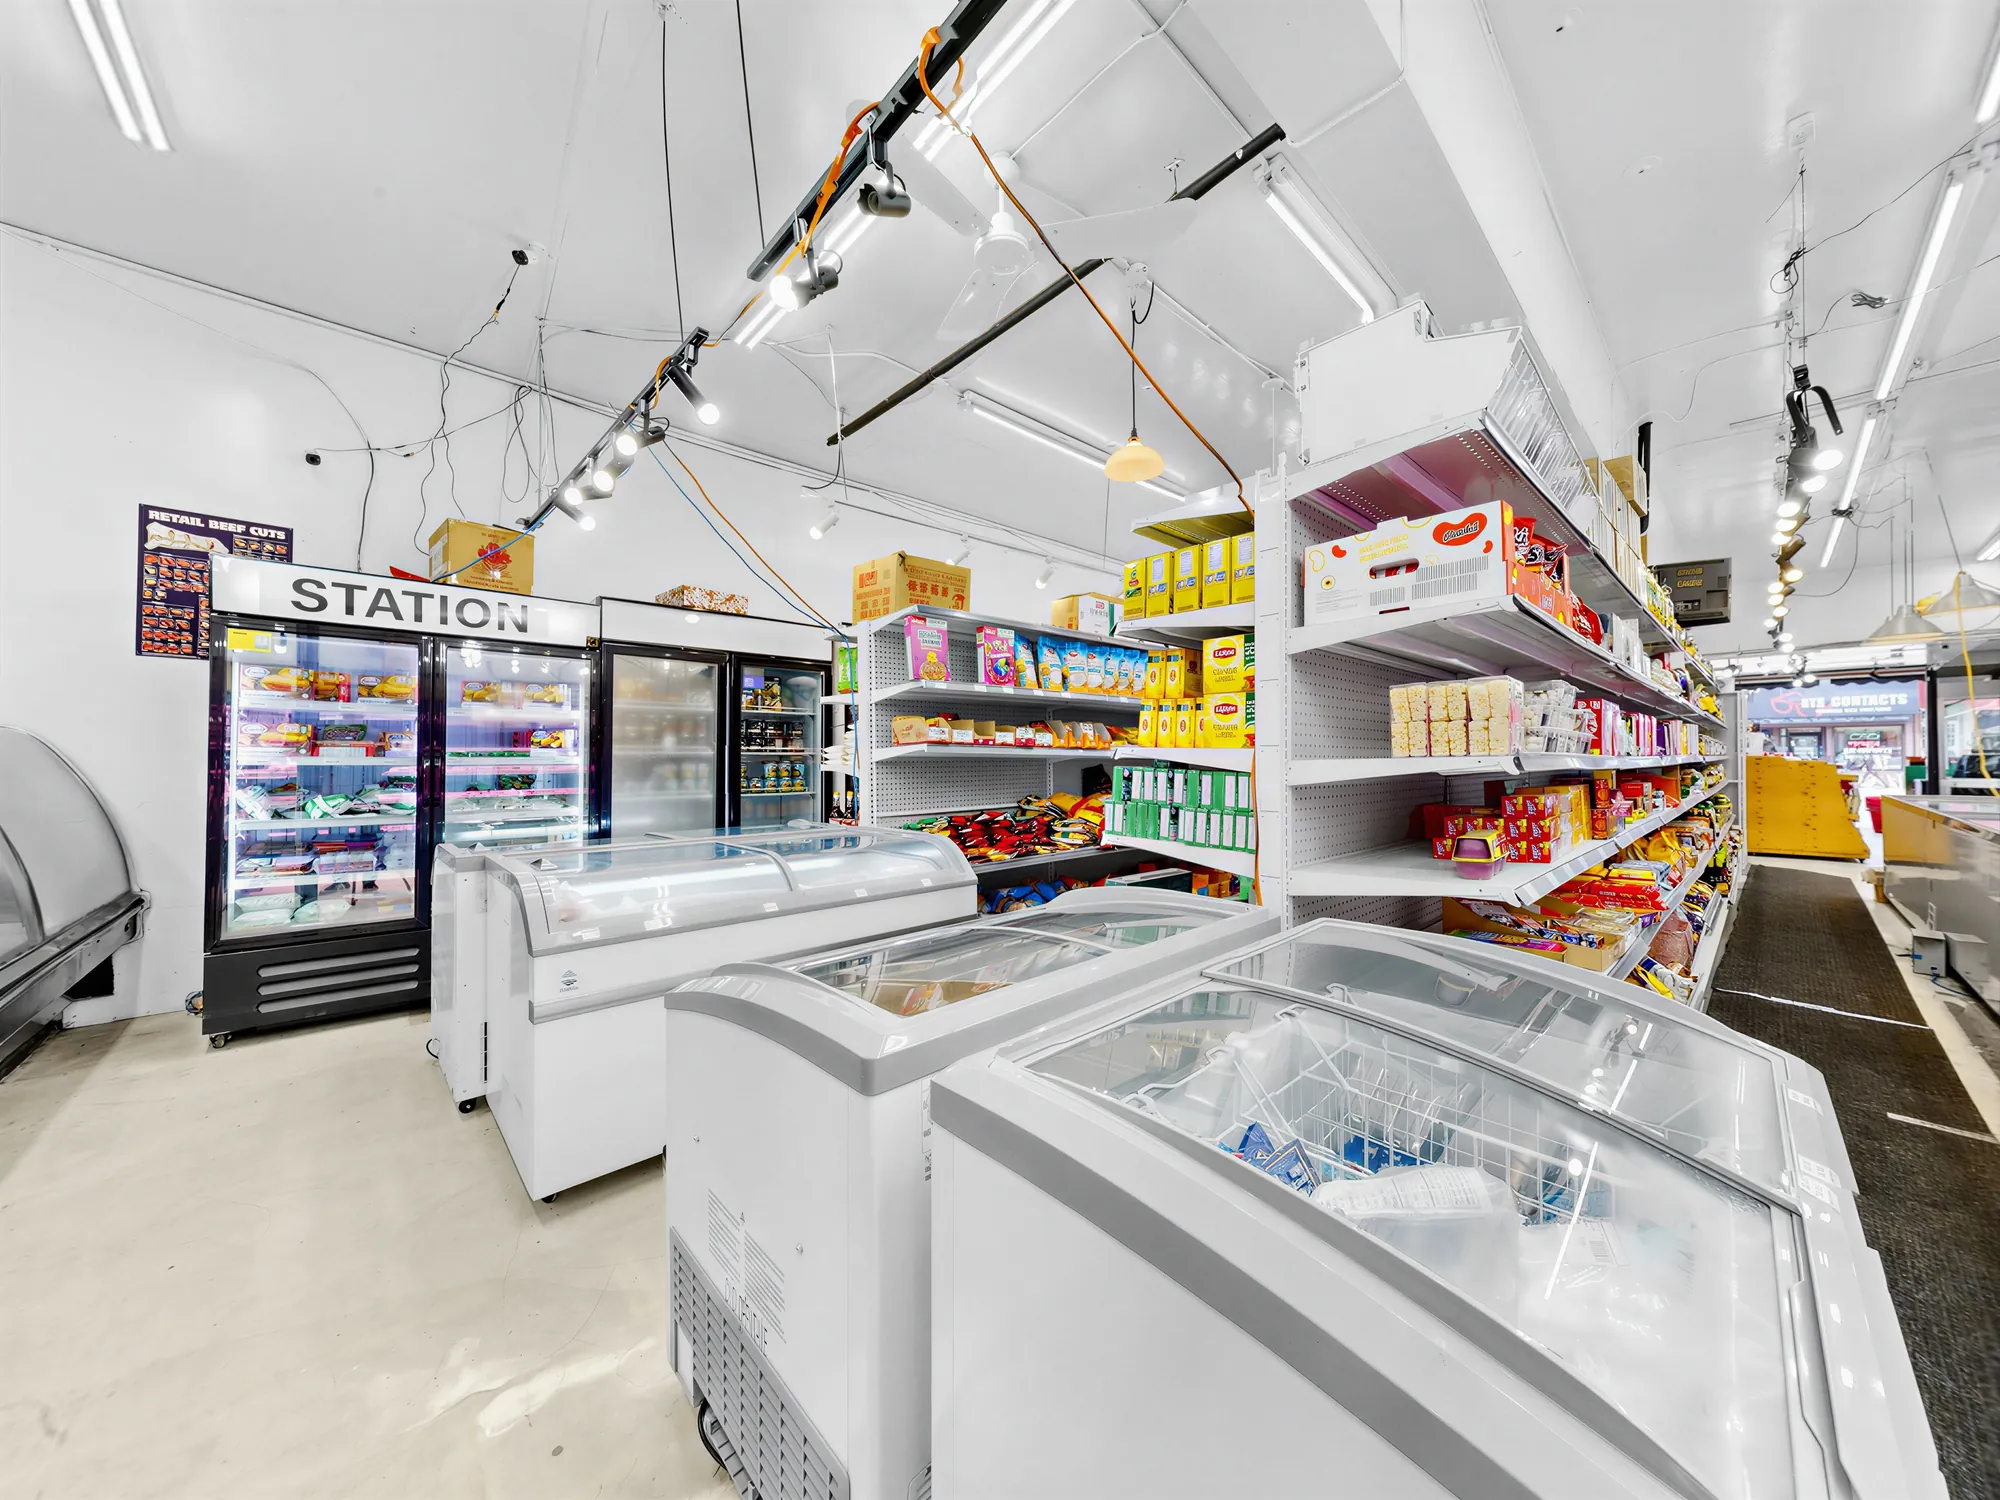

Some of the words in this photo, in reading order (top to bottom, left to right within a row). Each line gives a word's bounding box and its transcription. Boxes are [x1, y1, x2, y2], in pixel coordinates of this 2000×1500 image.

[148, 510, 205, 527] RETAIL
[208, 519, 247, 533] BEEF
[249, 526, 286, 540] CUTS
[291, 578, 528, 633] STATION
[1830, 693, 1908, 707] CONTACTS
